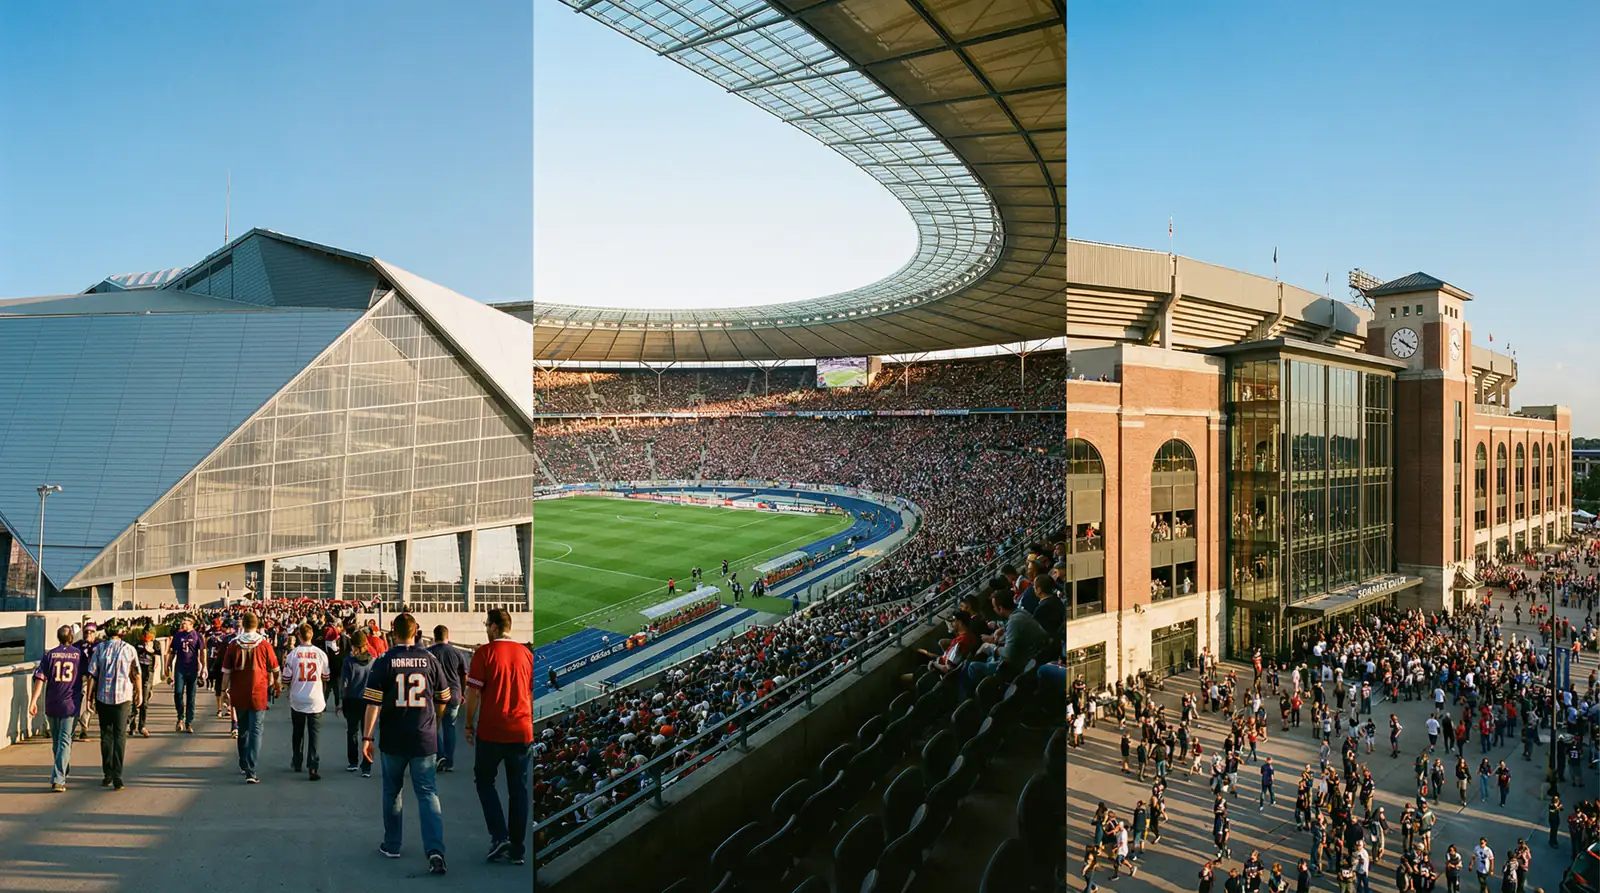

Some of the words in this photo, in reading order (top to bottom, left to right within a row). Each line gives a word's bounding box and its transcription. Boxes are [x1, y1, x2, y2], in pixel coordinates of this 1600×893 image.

[54, 660, 74, 682] 13
[298, 661, 317, 682] 12
[395, 672, 427, 708] 12
